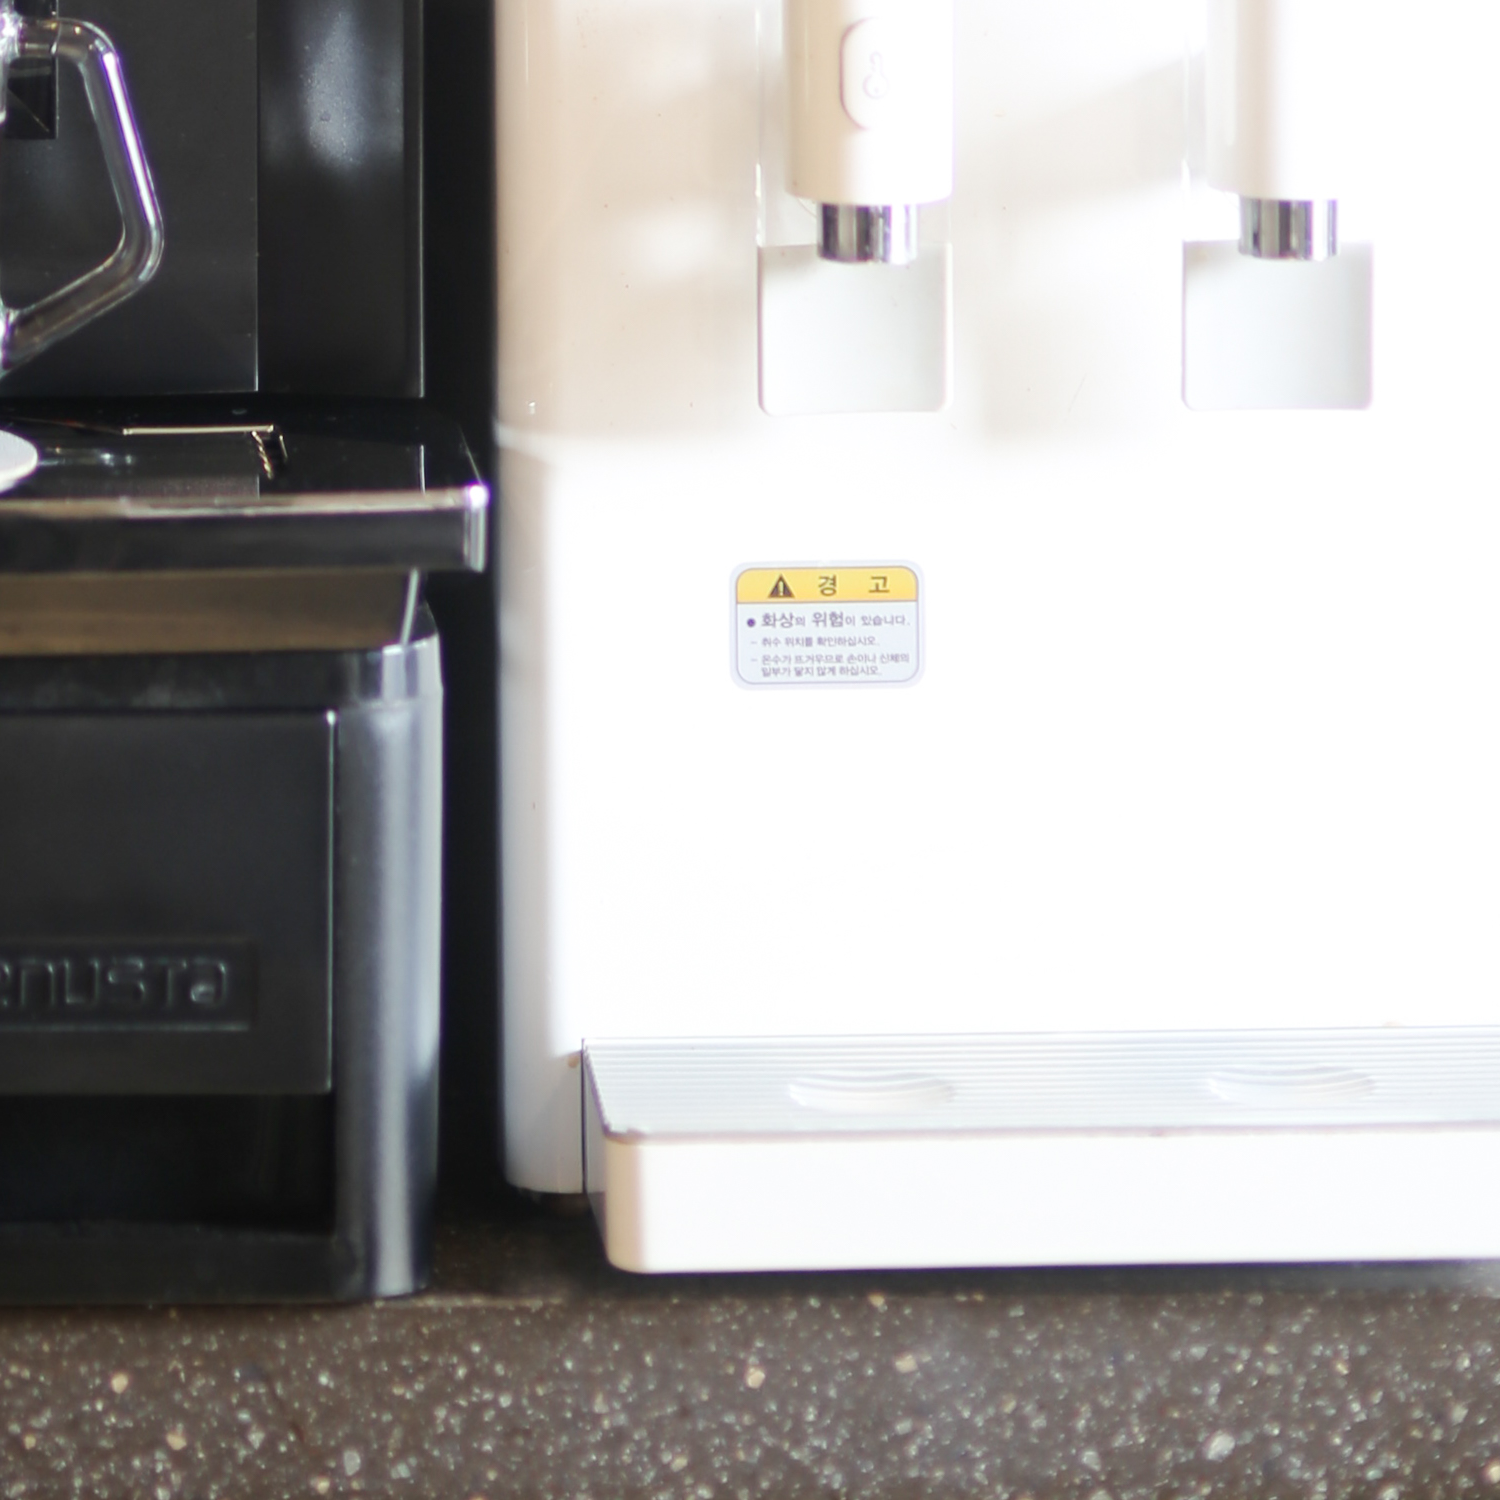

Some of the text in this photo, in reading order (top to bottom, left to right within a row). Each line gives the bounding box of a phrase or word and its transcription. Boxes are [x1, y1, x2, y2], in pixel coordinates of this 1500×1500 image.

[761, 611, 911, 628] 화상의 위험이 있습니다.
